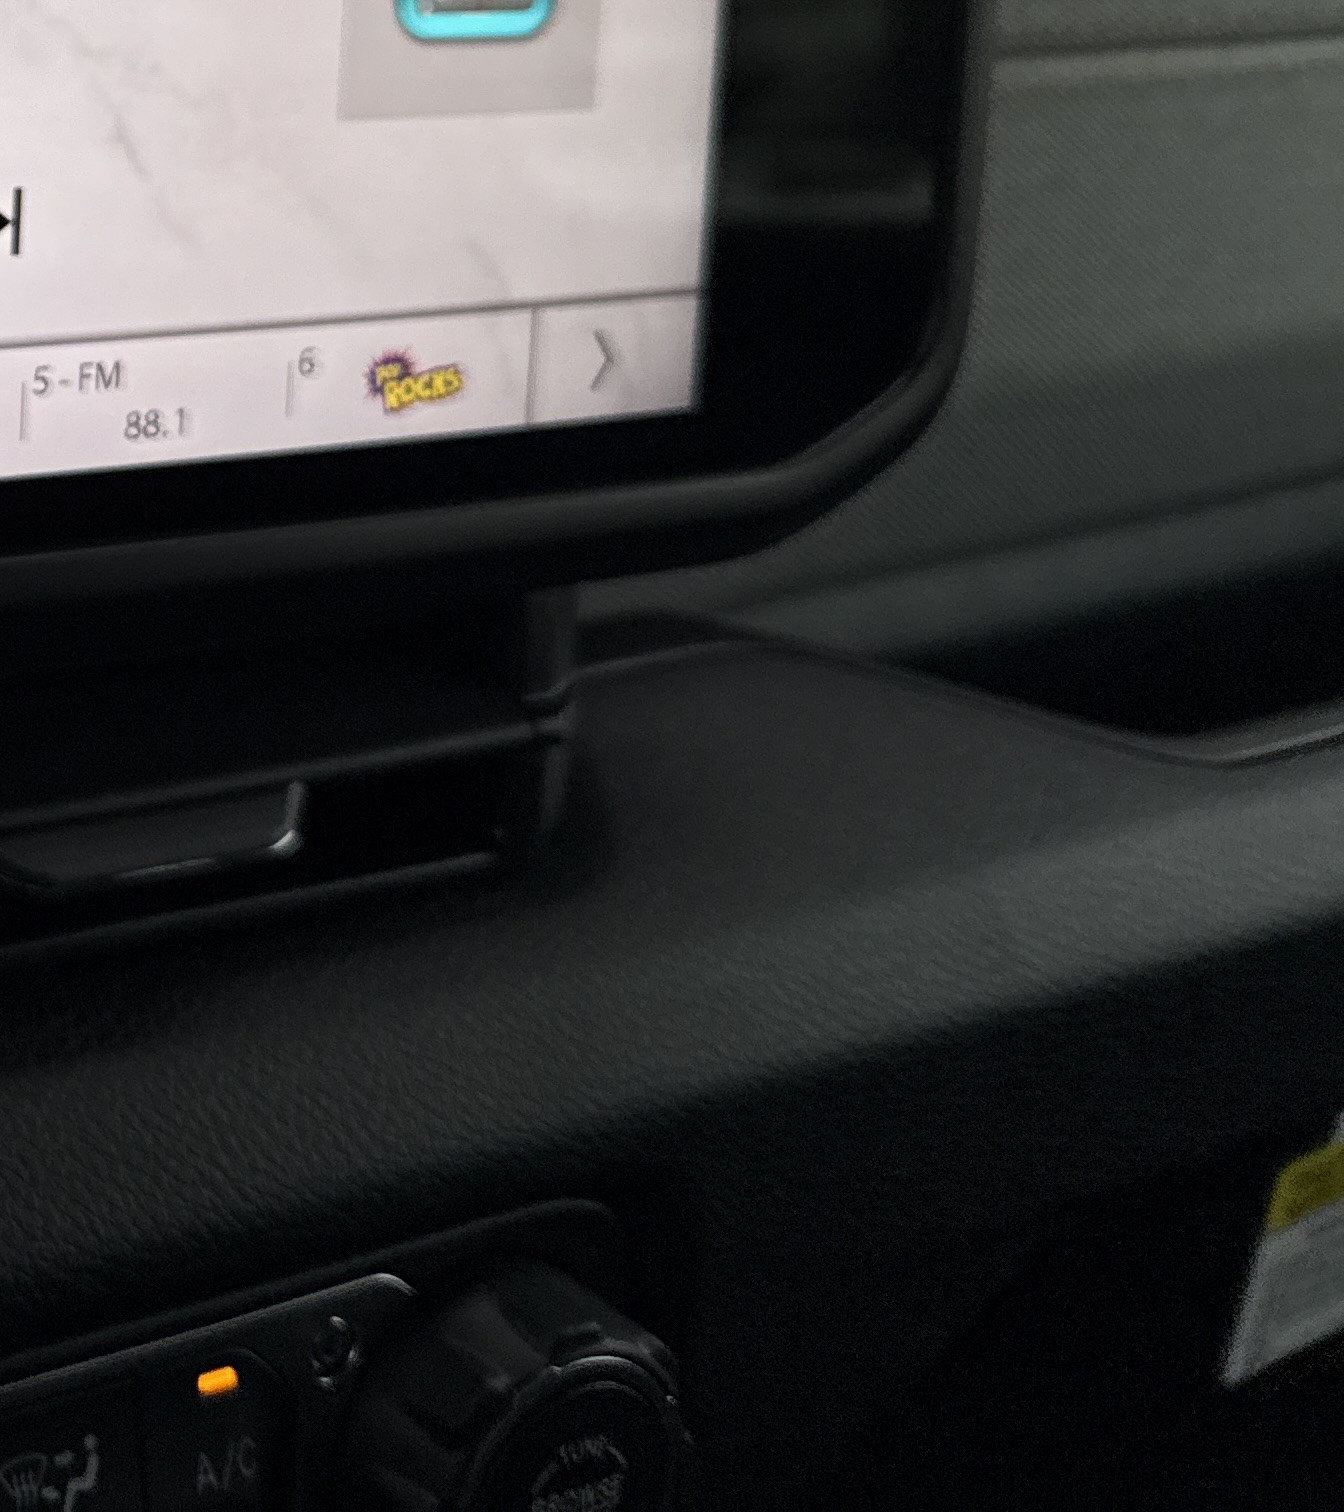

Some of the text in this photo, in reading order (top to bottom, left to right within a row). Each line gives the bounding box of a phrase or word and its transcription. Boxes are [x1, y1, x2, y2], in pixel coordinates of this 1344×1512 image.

[32, 364, 51, 396] 5
[78, 360, 122, 392] FM
[298, 346, 318, 378] 6
[124, 408, 188, 440] 88.1
[197, 1435, 256, 1494] A/C
